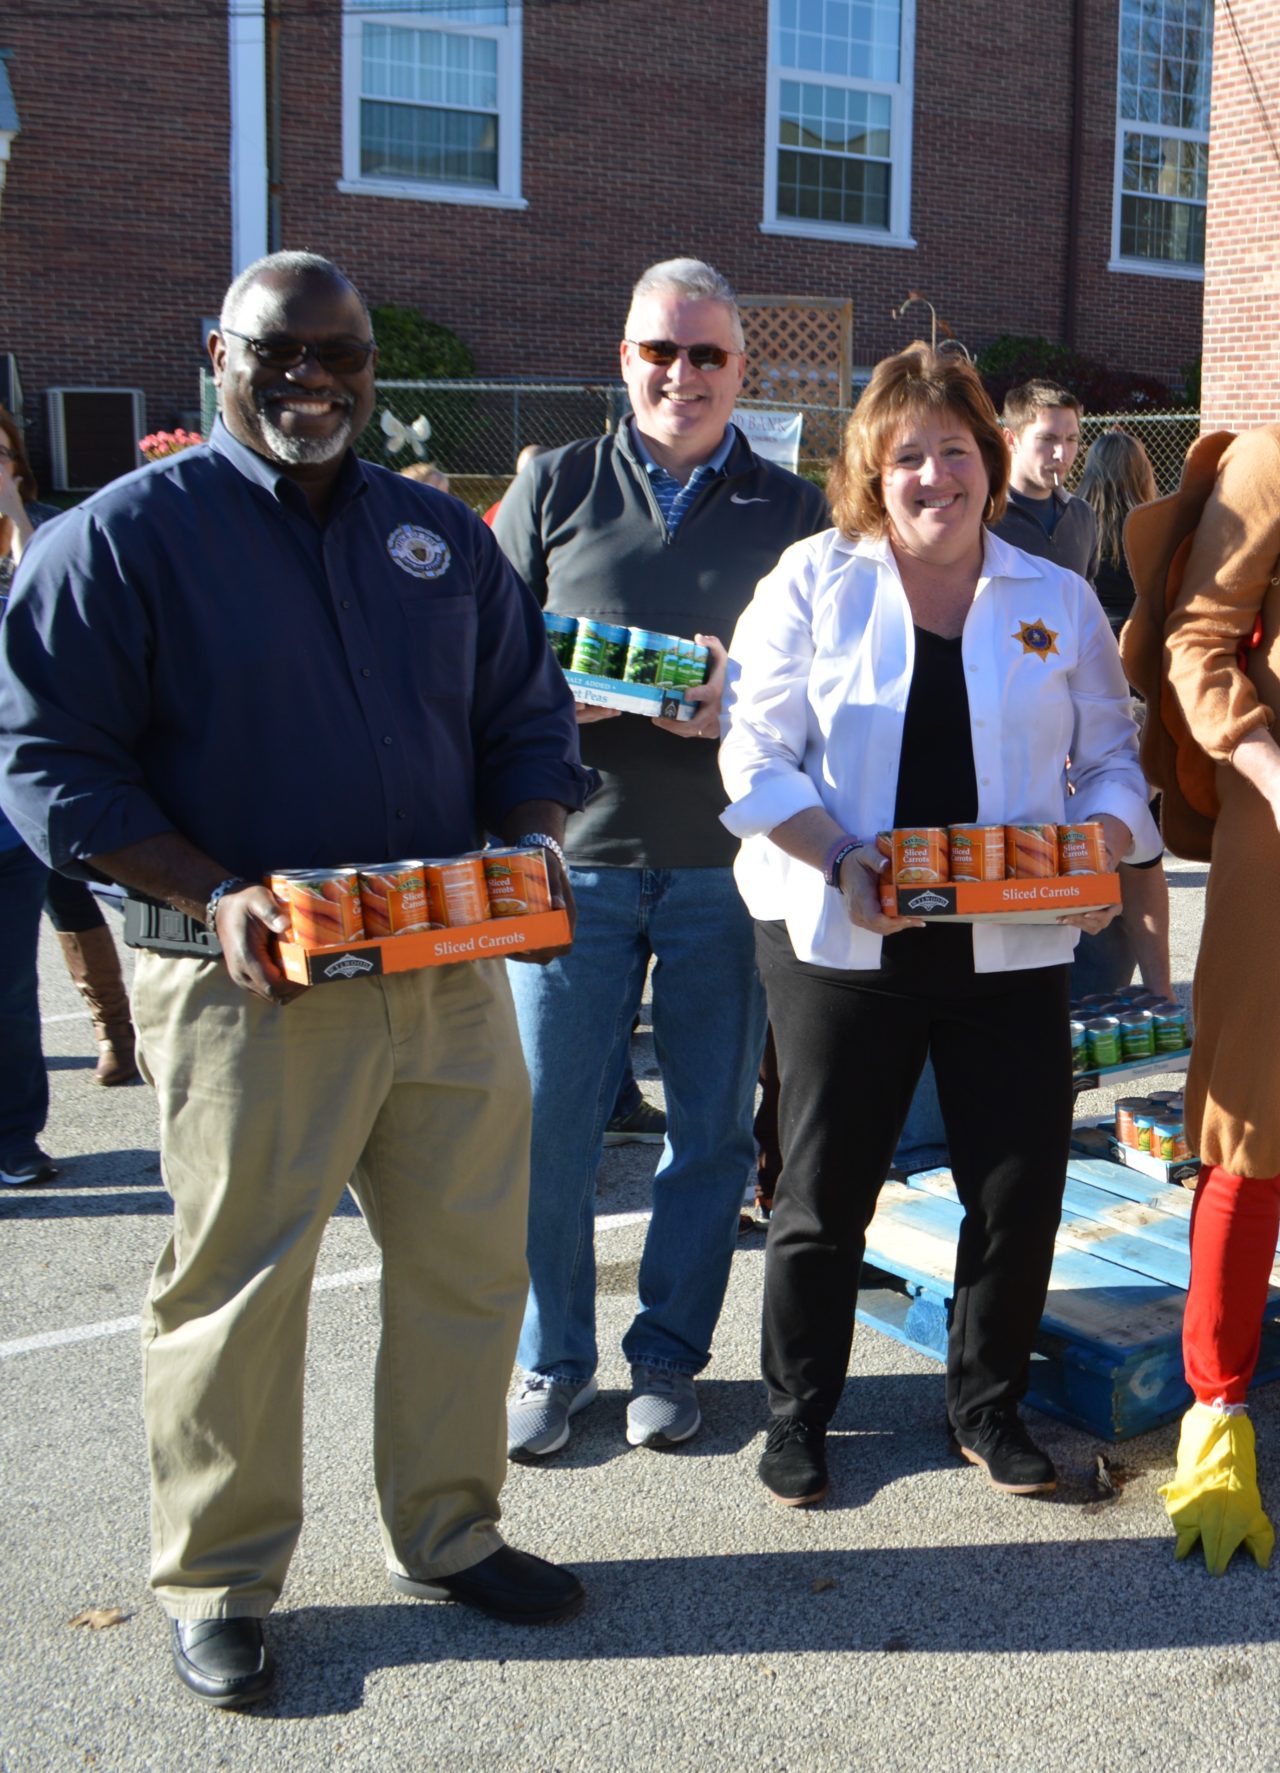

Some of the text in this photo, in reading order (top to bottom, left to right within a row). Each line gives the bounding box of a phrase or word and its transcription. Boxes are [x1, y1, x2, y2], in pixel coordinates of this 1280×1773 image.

[585, 690, 609, 702] Peas
[1003, 886, 1080, 901] Sliced Carrots
[434, 931, 526, 956] Sliced Carrots
